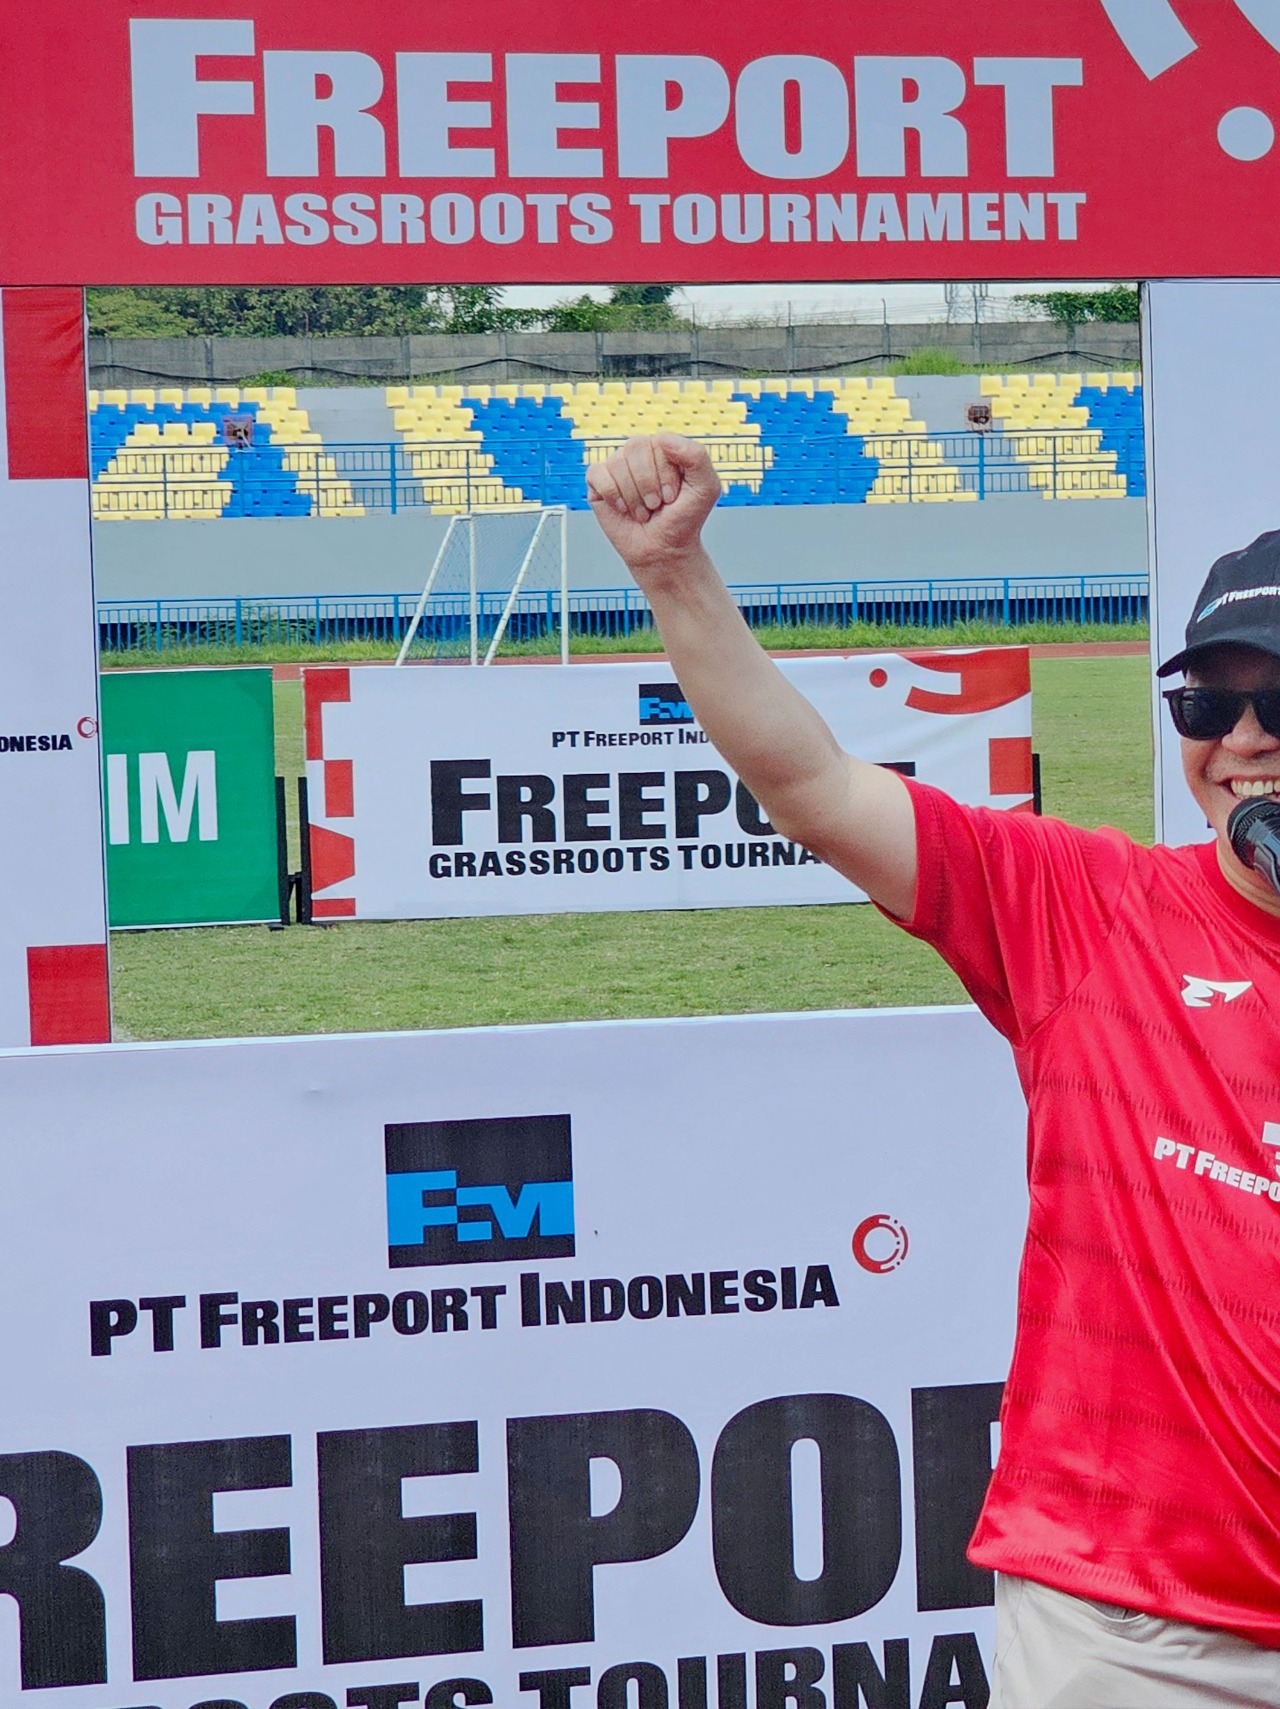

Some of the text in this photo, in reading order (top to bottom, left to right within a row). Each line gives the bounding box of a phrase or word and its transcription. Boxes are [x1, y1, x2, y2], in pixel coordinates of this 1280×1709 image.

[129, 18, 1084, 180] FREEPORT
[134, 192, 1087, 246] GRASSROOTS TOURNAMENT
[552, 731, 580, 748] PT
[584, 731, 674, 747] FREEPORT
[428, 846, 670, 879] GRASSROOTS
[1154, 1136, 1195, 1169] PT
[89, 1264, 840, 1357] PT FREEPORT INDONESIA
